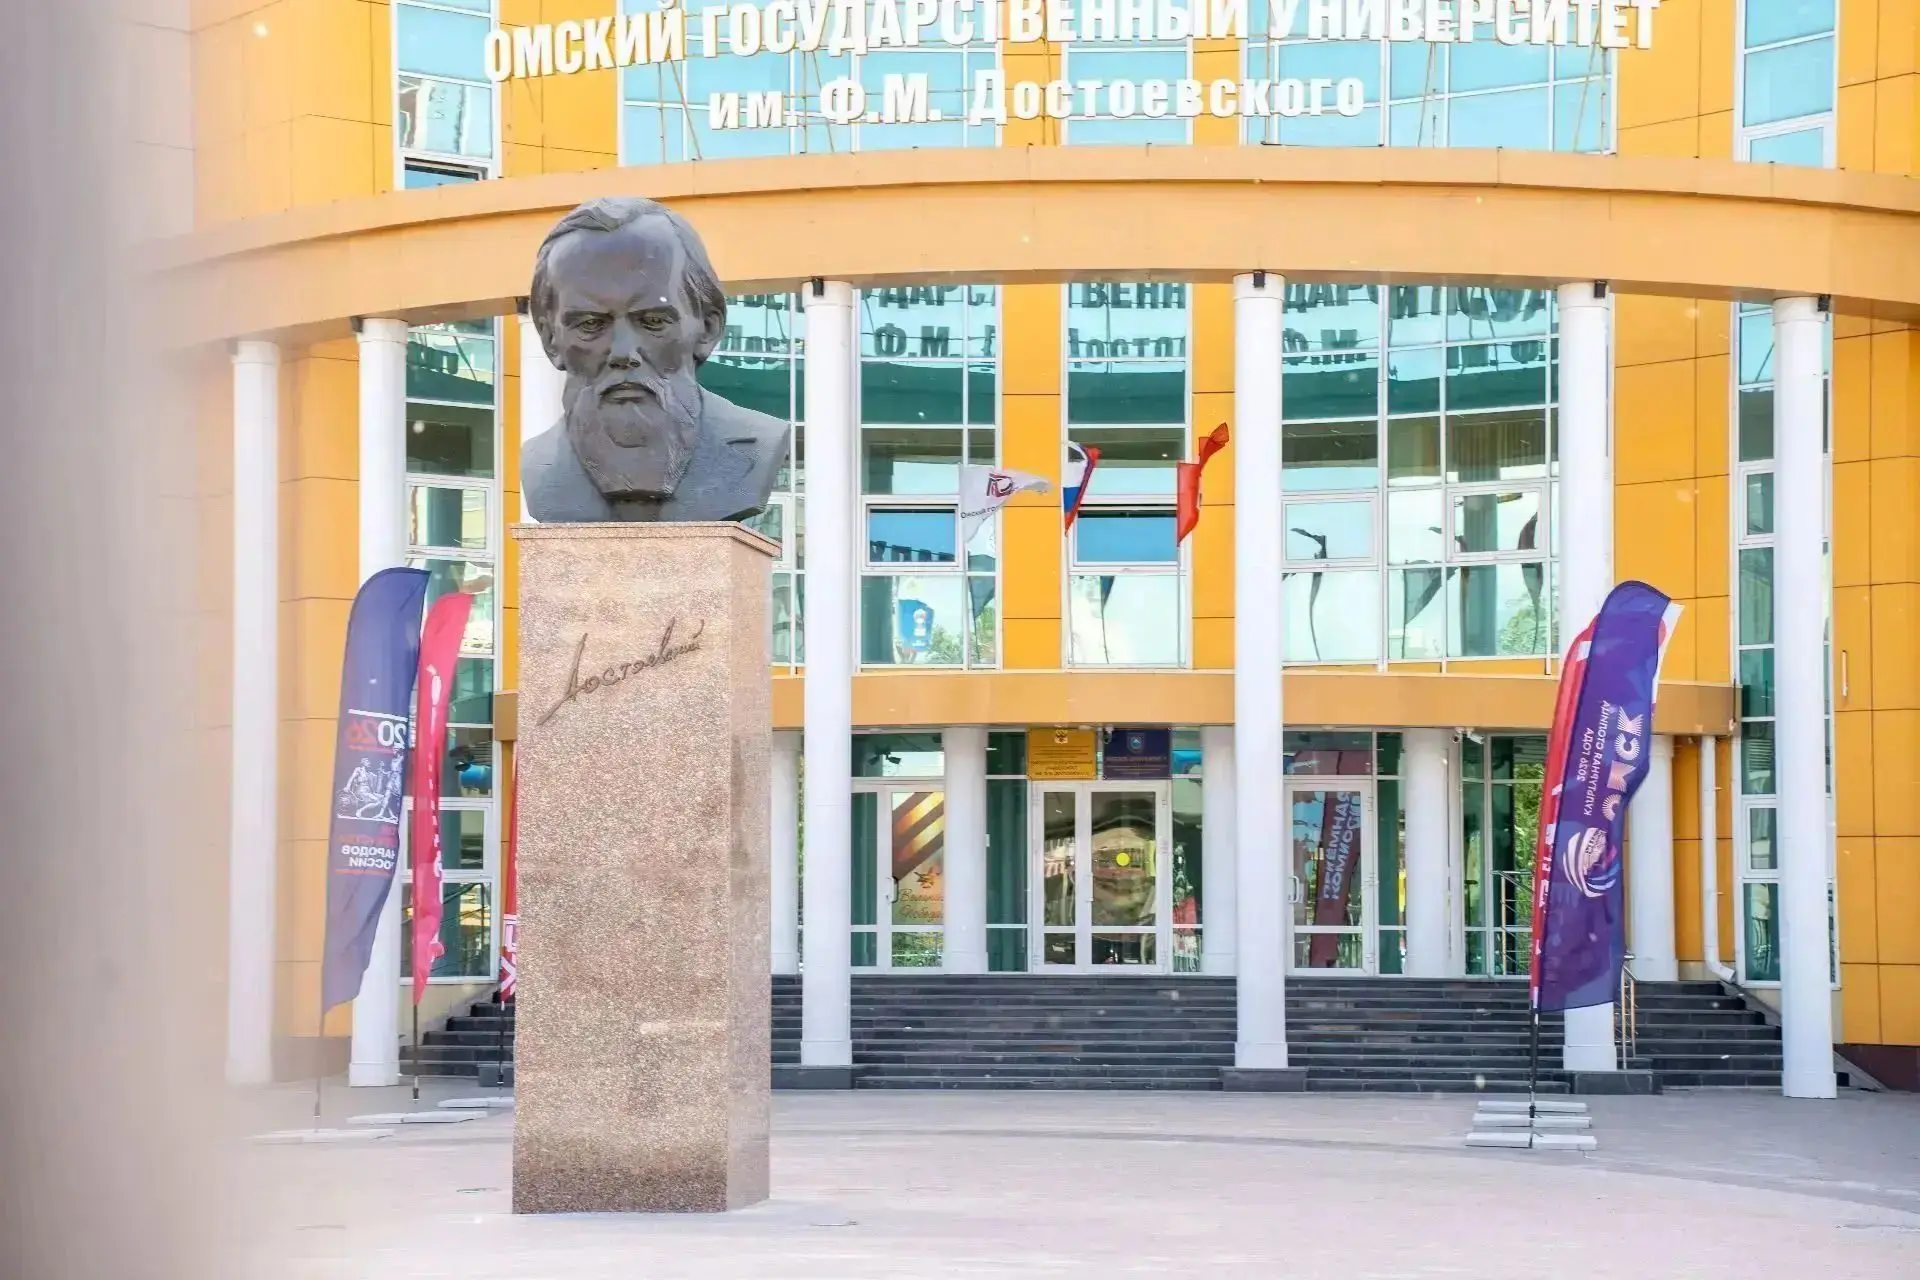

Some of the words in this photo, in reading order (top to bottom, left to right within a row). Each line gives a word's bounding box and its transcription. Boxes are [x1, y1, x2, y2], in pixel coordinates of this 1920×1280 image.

[484, 0, 686, 81] ОМСКИЙ
[1270, 0, 1660, 50] УНИВЕРСИТЕТ
[709, 90, 798, 129] им.
[820, 73, 943, 124] Ф.М.
[967, 68, 1365, 126] Достоевского
